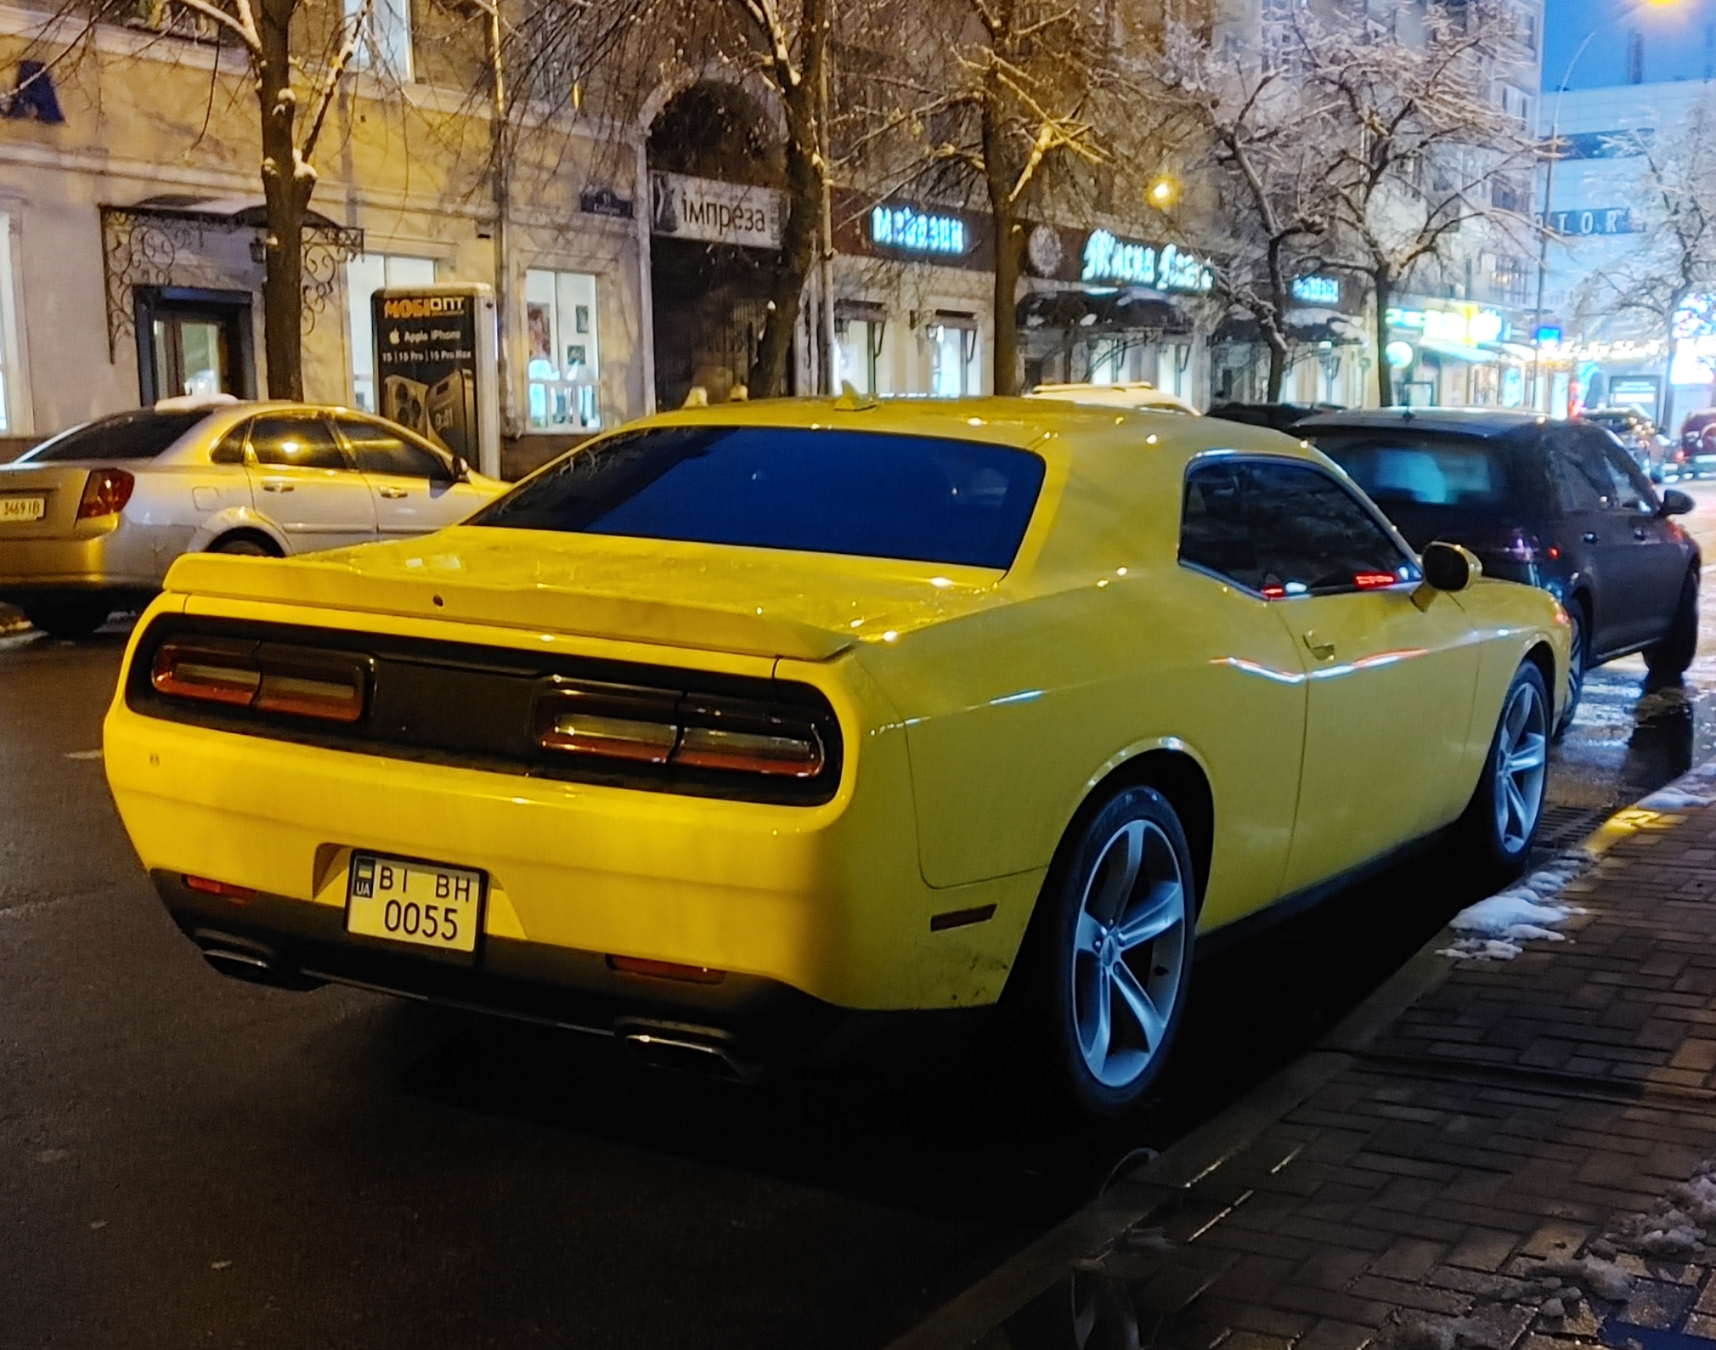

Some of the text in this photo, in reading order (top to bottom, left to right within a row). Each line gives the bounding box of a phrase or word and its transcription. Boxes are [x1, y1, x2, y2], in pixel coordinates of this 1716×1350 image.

[404, 329, 461, 344] Apple iPhone
[356, 881, 371, 897] UA
[379, 865, 470, 902] BI BH
[384, 899, 458, 941] 0055
